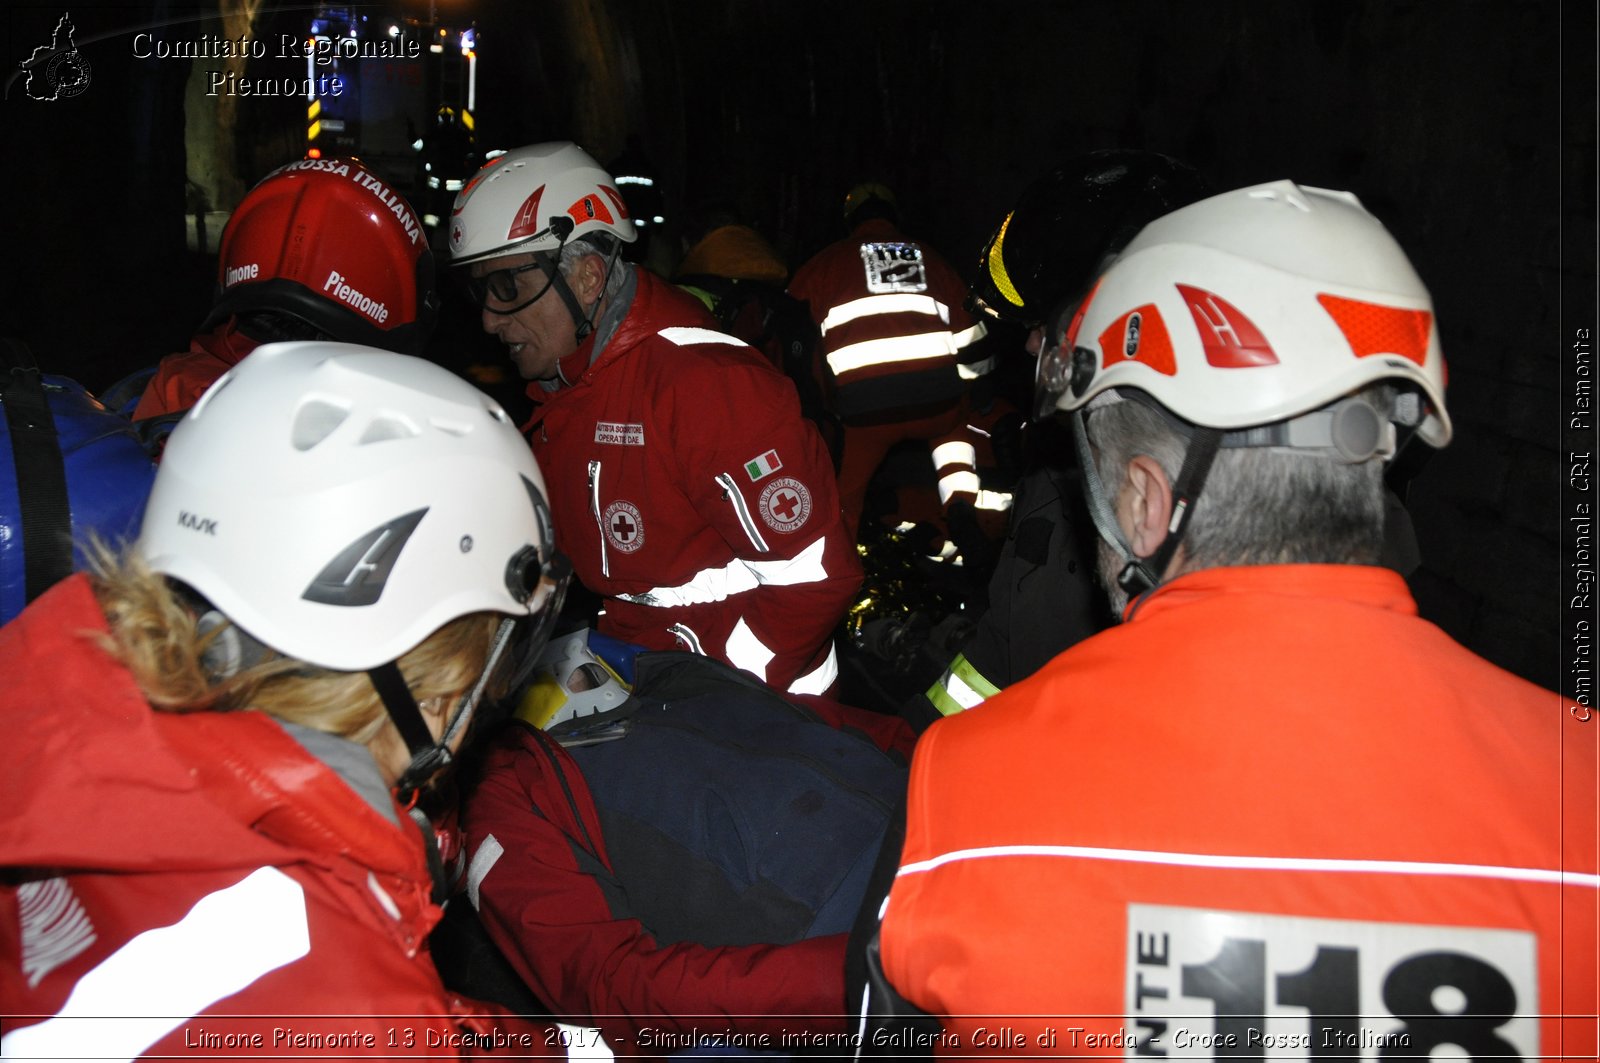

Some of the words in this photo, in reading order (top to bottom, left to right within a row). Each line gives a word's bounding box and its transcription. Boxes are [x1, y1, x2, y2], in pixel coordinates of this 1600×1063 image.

[287, 159, 350, 177] ROSSA
[353, 171, 420, 245] ITALIANA
[226, 263, 259, 288] Limone
[323, 270, 389, 324] Piemonte
[1135, 930, 1169, 1059] NTE
[1181, 936, 1525, 1063] 118
